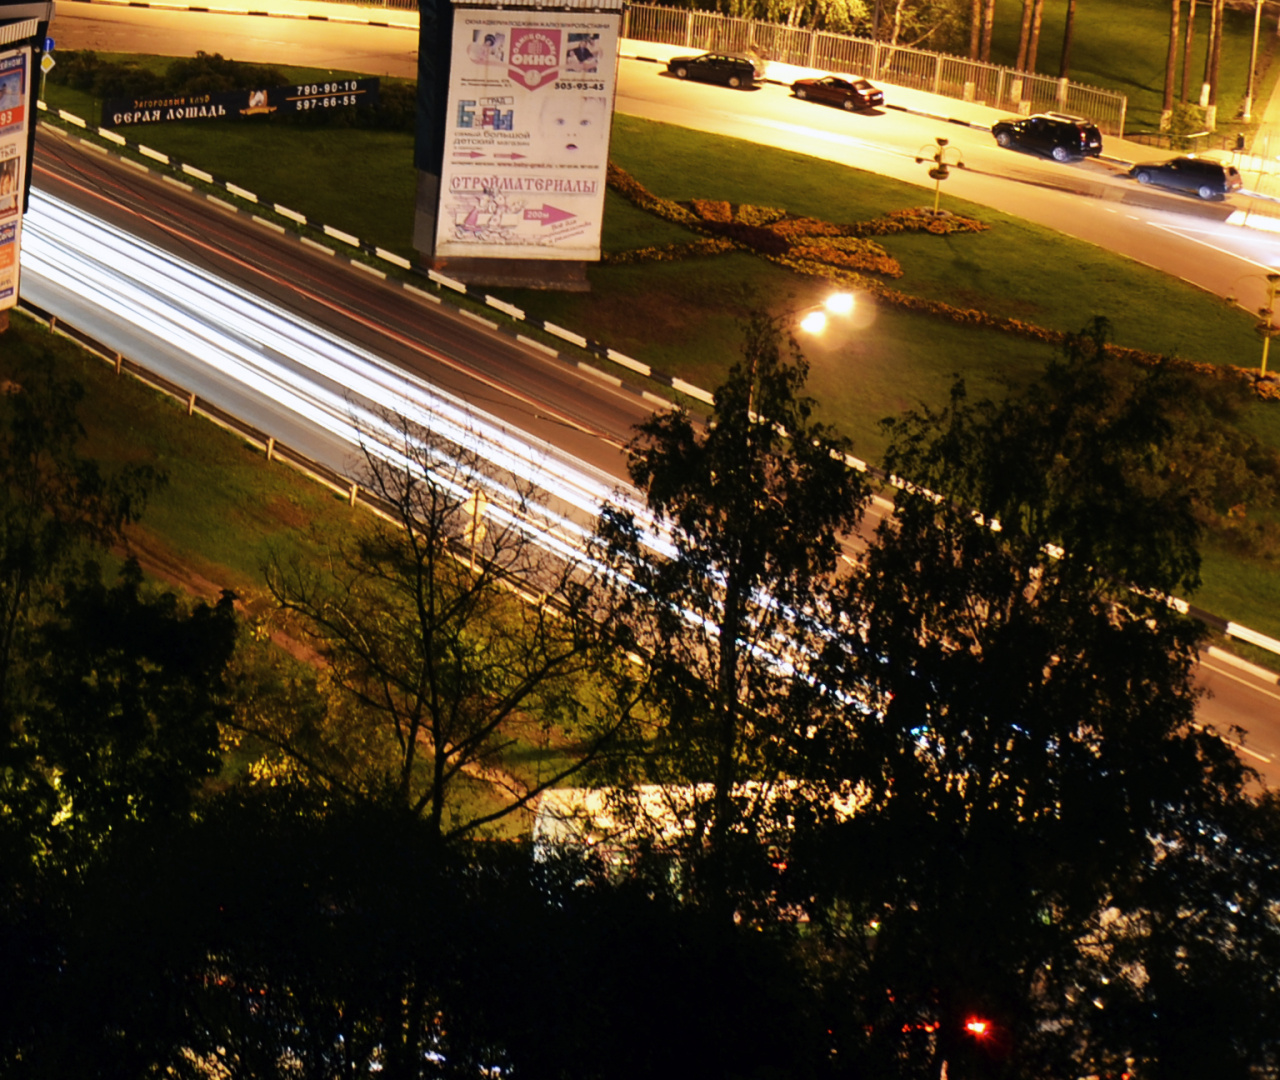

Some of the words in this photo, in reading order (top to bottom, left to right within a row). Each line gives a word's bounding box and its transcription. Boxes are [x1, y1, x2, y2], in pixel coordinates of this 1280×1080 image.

[297, 80, 358, 97] 790-90-10
[296, 95, 357, 111] 597-66-55
[113, 108, 161, 125] СЕРАЯ
[166, 105, 227, 121] ЛОШАДЬ
[452, 175, 596, 193] СТРОЙМАТЕРИАЛЫ
